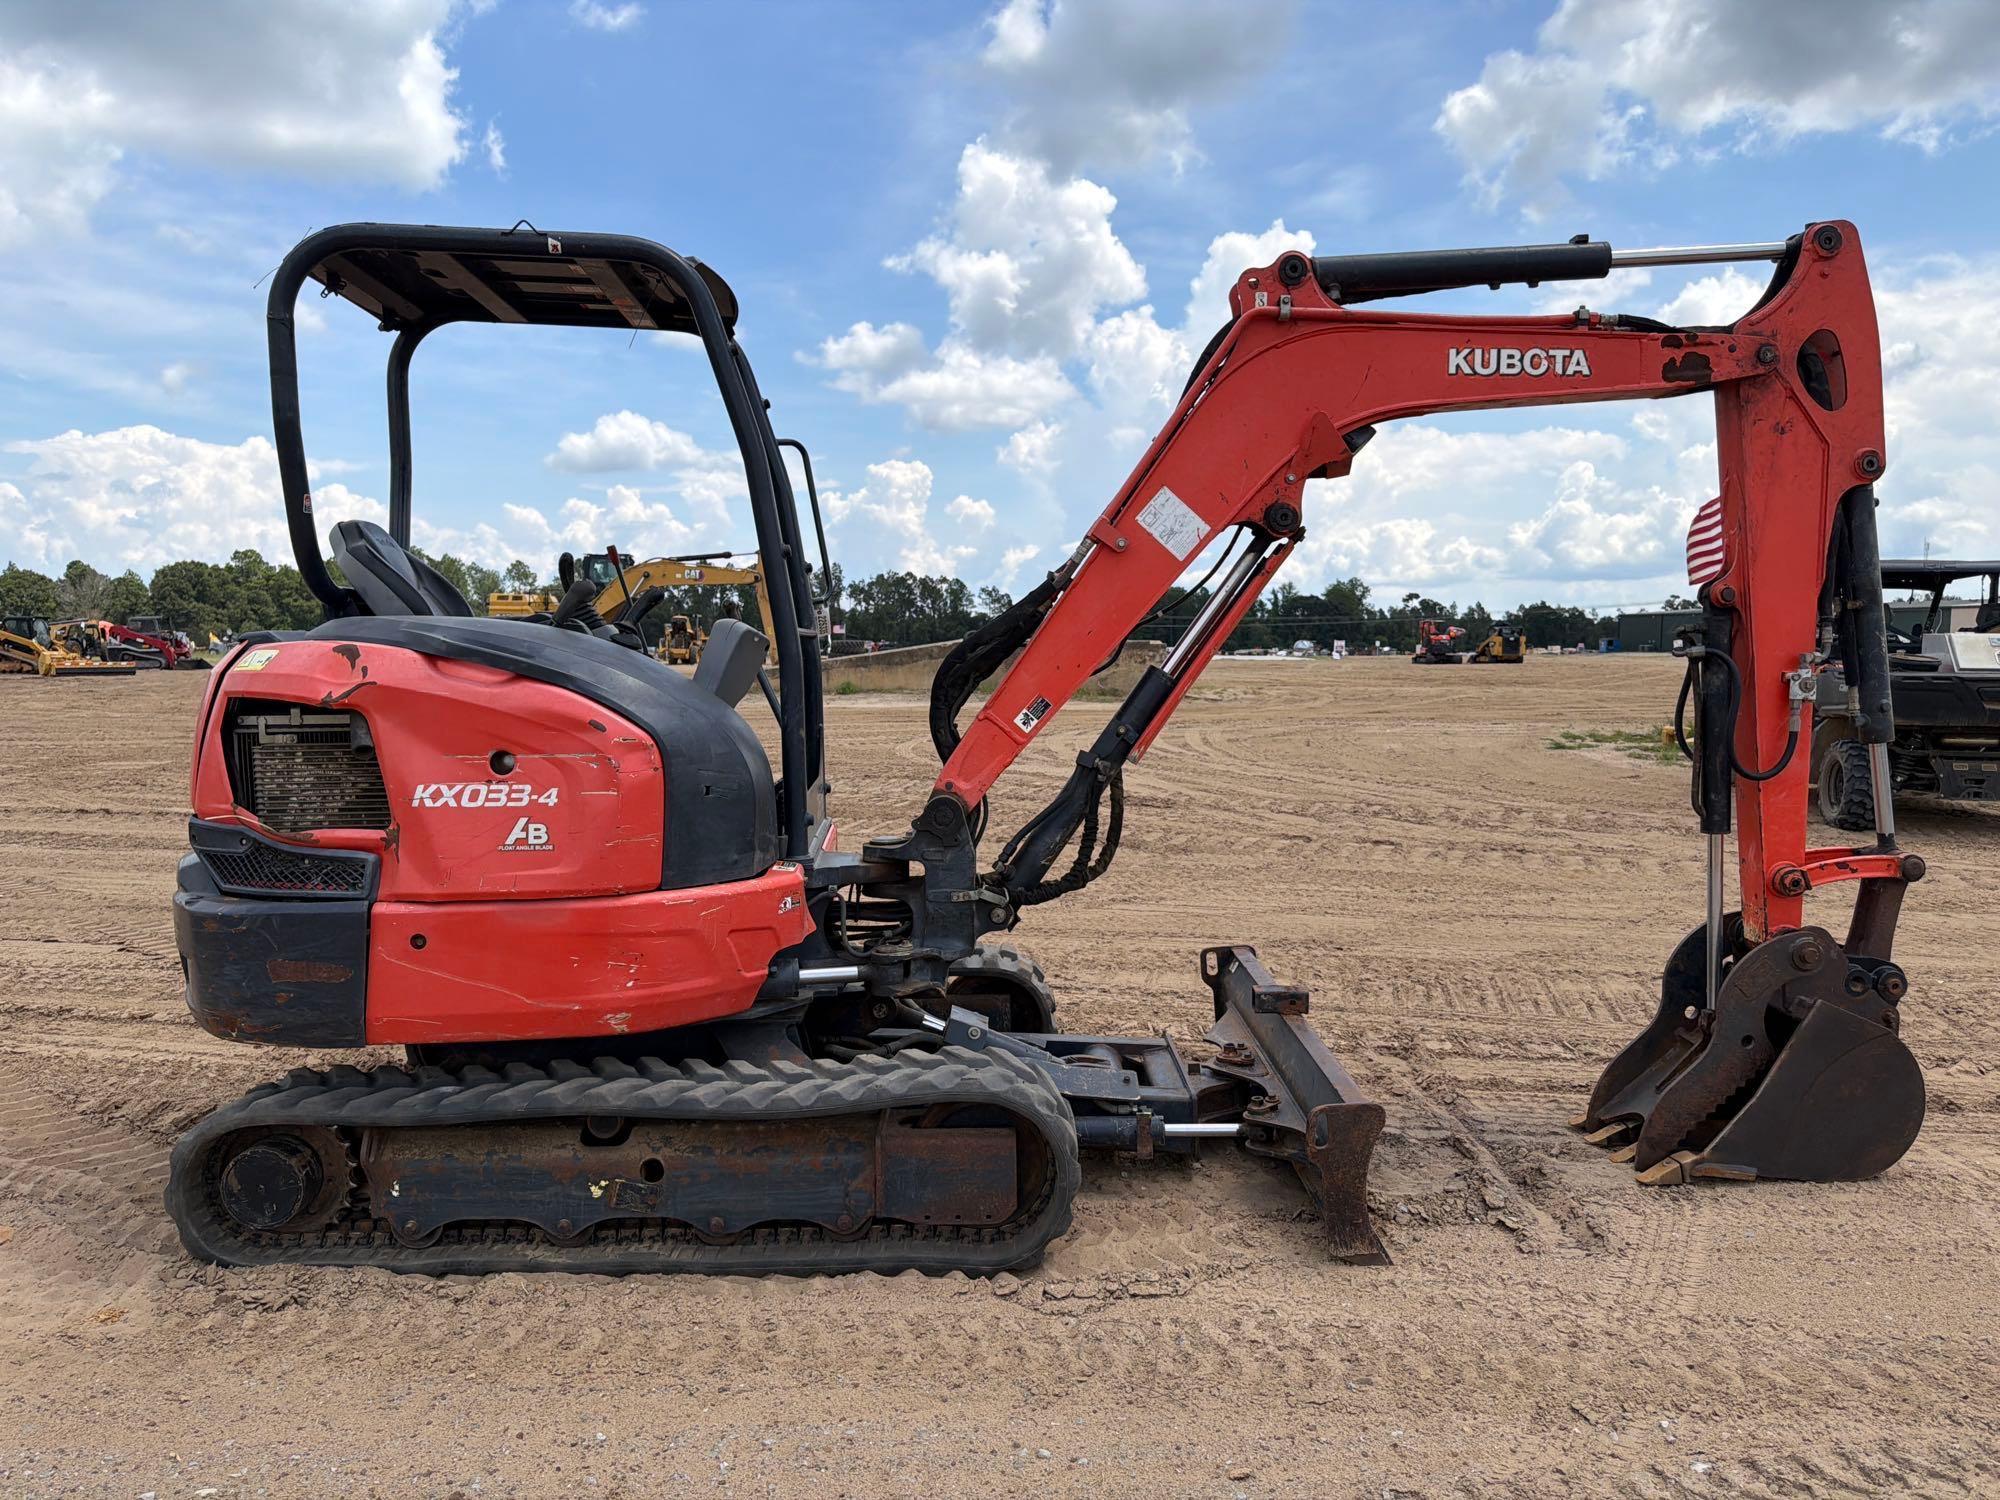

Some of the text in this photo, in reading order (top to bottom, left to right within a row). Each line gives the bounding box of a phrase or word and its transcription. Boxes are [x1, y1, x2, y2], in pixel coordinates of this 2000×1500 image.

[1447, 347, 1592, 377] KUBOTA
[684, 569, 701, 580] CAT
[412, 784, 559, 807] KX033-4
